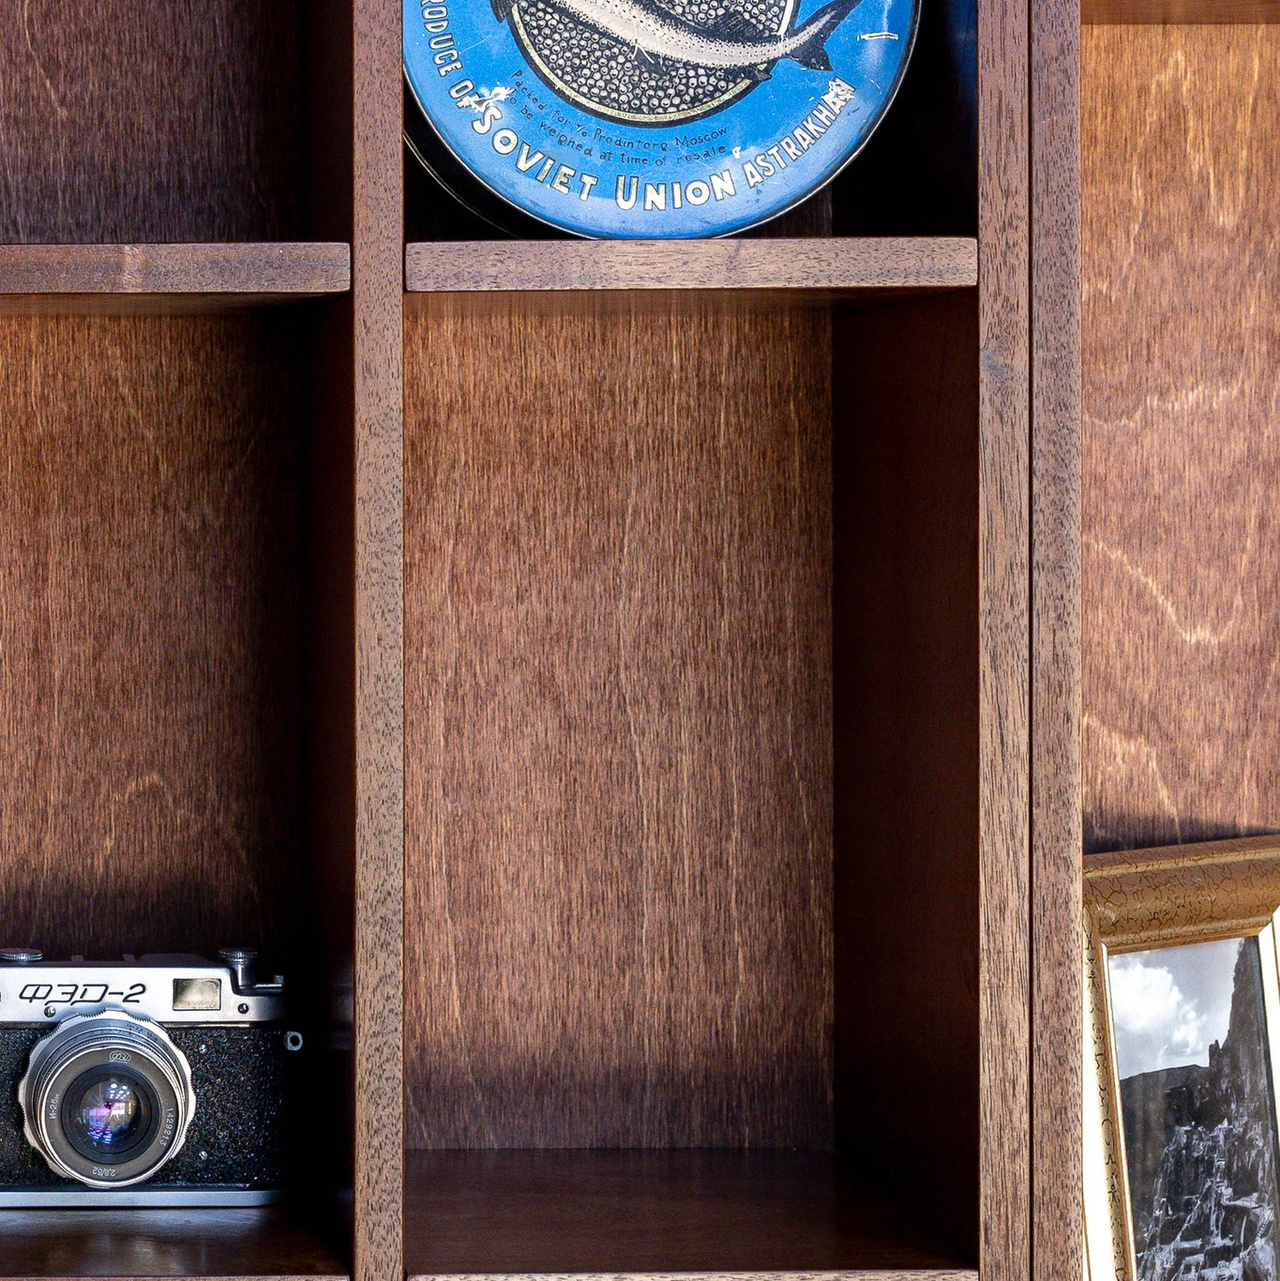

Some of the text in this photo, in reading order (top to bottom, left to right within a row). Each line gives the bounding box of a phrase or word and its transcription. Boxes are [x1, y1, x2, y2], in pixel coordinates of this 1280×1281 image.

[509, 69, 548, 111] Packed
[551, 109, 571, 126] for
[674, 126, 728, 149] Moscow
[520, 104, 534, 120] be
[599, 150, 614, 162] at
[620, 152, 649, 166] time
[654, 155, 668, 167] of
[676, 145, 727, 165] resale
[471, 104, 737, 211] SOVIET UNION
[18, 983, 147, 1007] ФЭД-2
